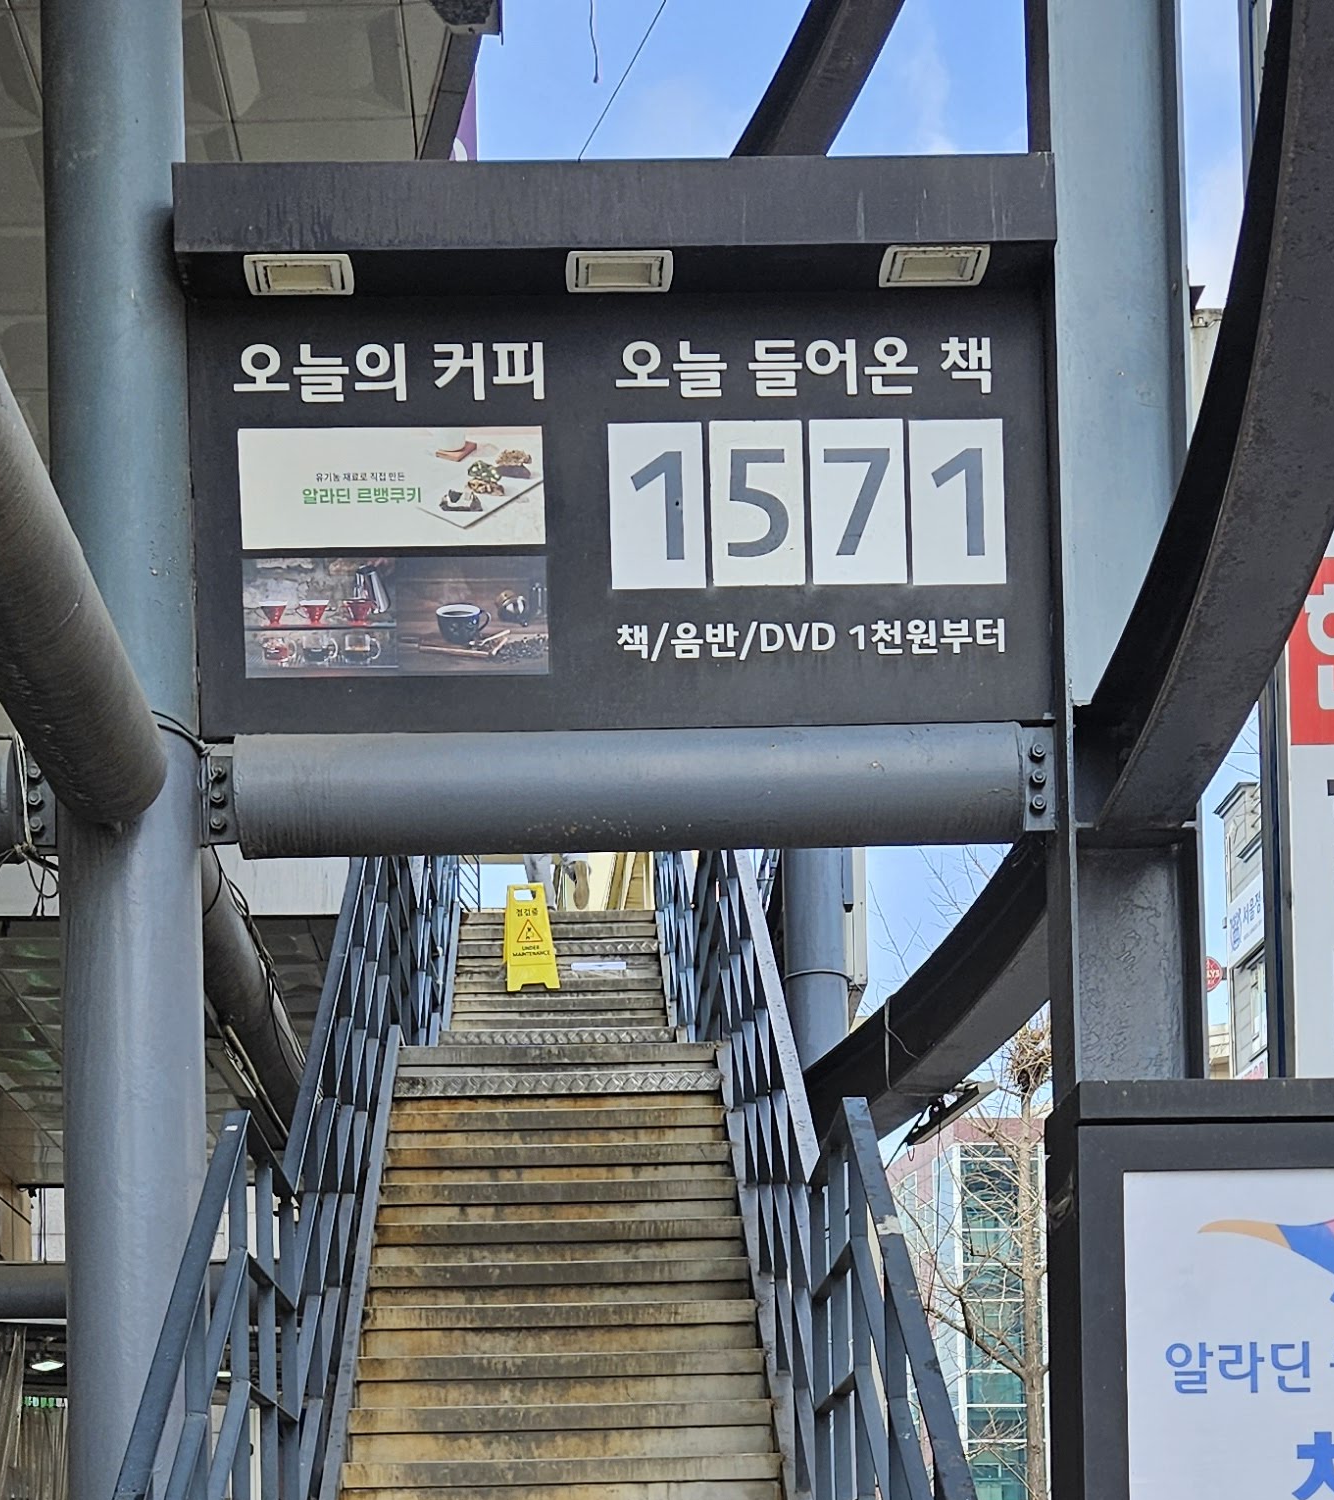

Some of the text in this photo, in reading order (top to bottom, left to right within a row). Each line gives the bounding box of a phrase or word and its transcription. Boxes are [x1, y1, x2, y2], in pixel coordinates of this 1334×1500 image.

[232, 341, 545, 402] 오늘의 커피
[615, 336, 992, 397] 오늘 들어온 책
[302, 487, 422, 504] 알라딘 르뱅쿠키
[316, 472, 340, 482] 유기농
[616, 617, 1006, 661] 책/음반/DVD 1천원부터
[1165, 1340, 1312, 1394] 알라딘
